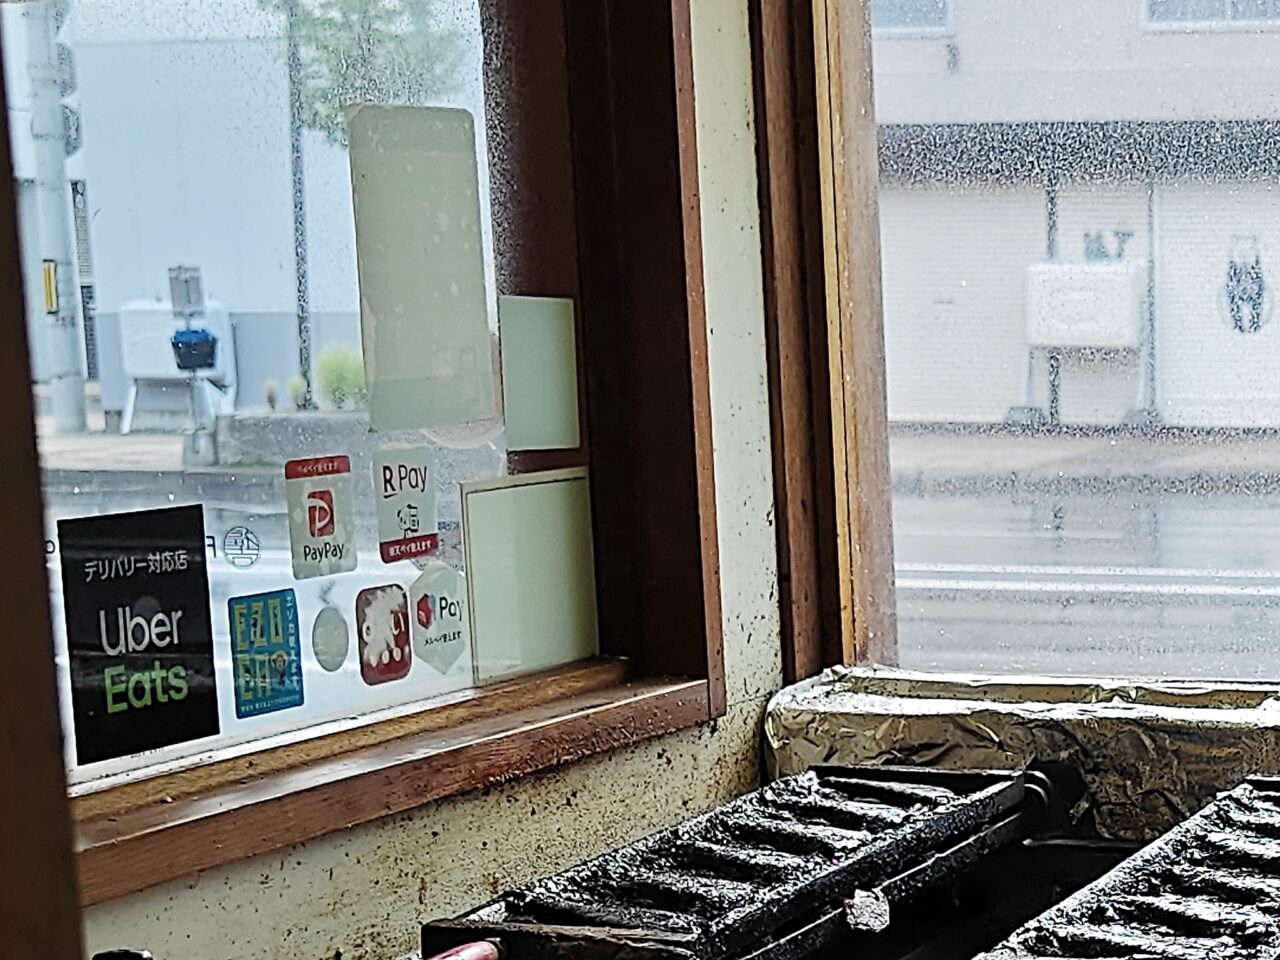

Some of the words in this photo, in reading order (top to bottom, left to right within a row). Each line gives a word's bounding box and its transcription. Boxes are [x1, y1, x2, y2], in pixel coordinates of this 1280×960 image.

[398, 464, 428, 493] Pay
[84, 549, 189, 582] デリバリー対応店
[303, 541, 345, 564] PayPay
[438, 595, 464, 622] Pay
[100, 605, 183, 656] Uber
[104, 660, 189, 714] Eats
